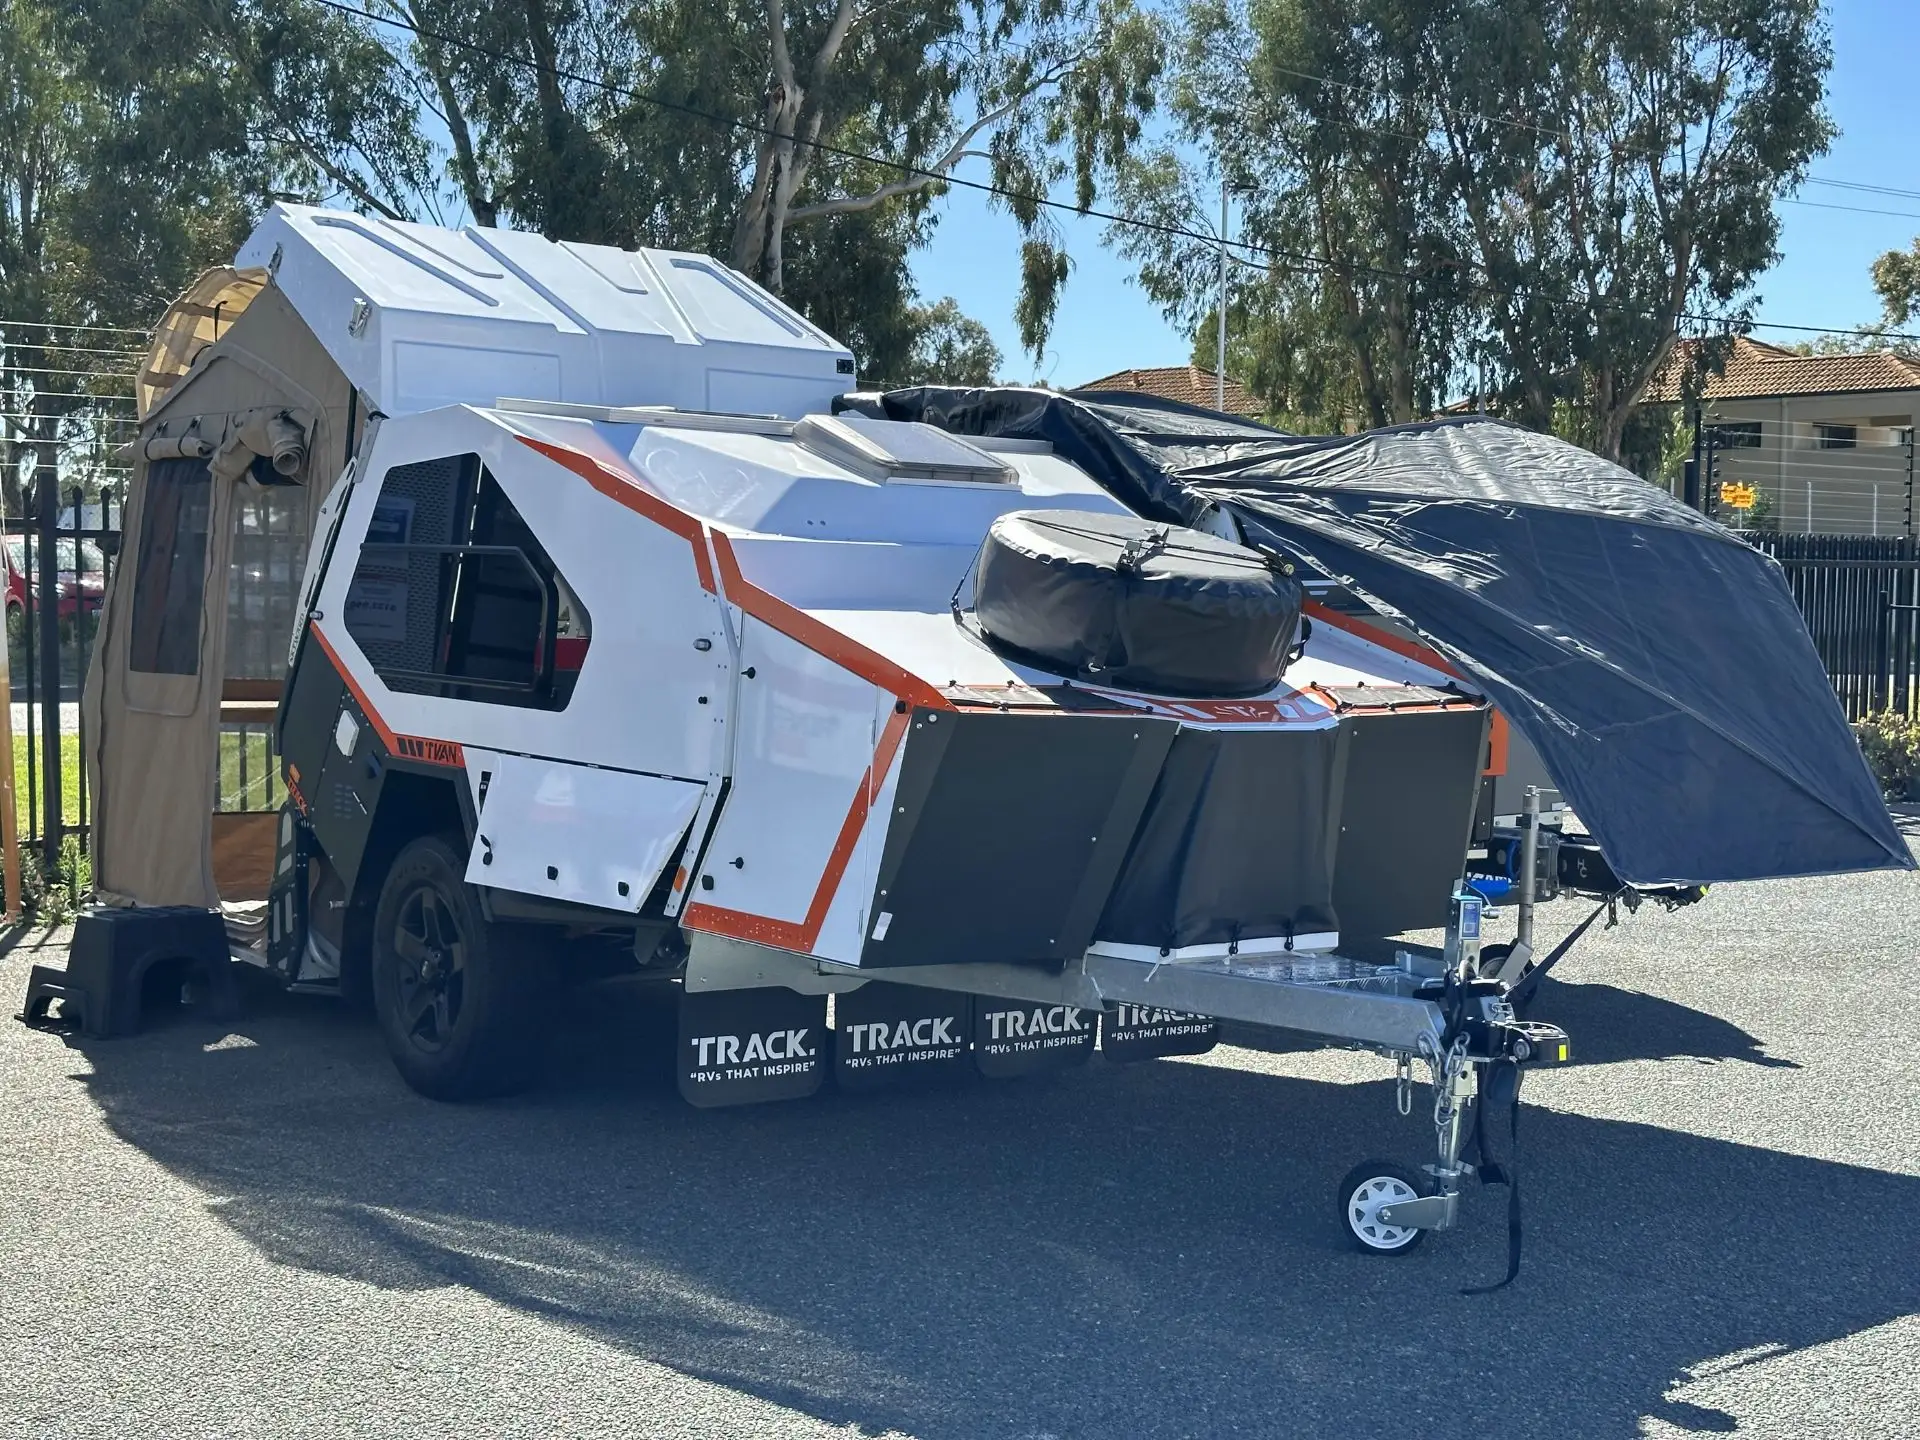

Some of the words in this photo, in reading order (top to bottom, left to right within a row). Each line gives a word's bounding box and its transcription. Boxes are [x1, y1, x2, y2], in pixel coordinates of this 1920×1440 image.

[425, 741, 457, 763] TVAN
[985, 1006, 1090, 1040] TRACK.
[846, 1016, 962, 1053] TRACK.
[1138, 1027, 1164, 1039] THAT
[691, 1028, 816, 1067] TRACK.
[1014, 1040, 1041, 1052] THAT
[875, 1052, 905, 1065] THAT
[725, 1067, 760, 1080] THAT
